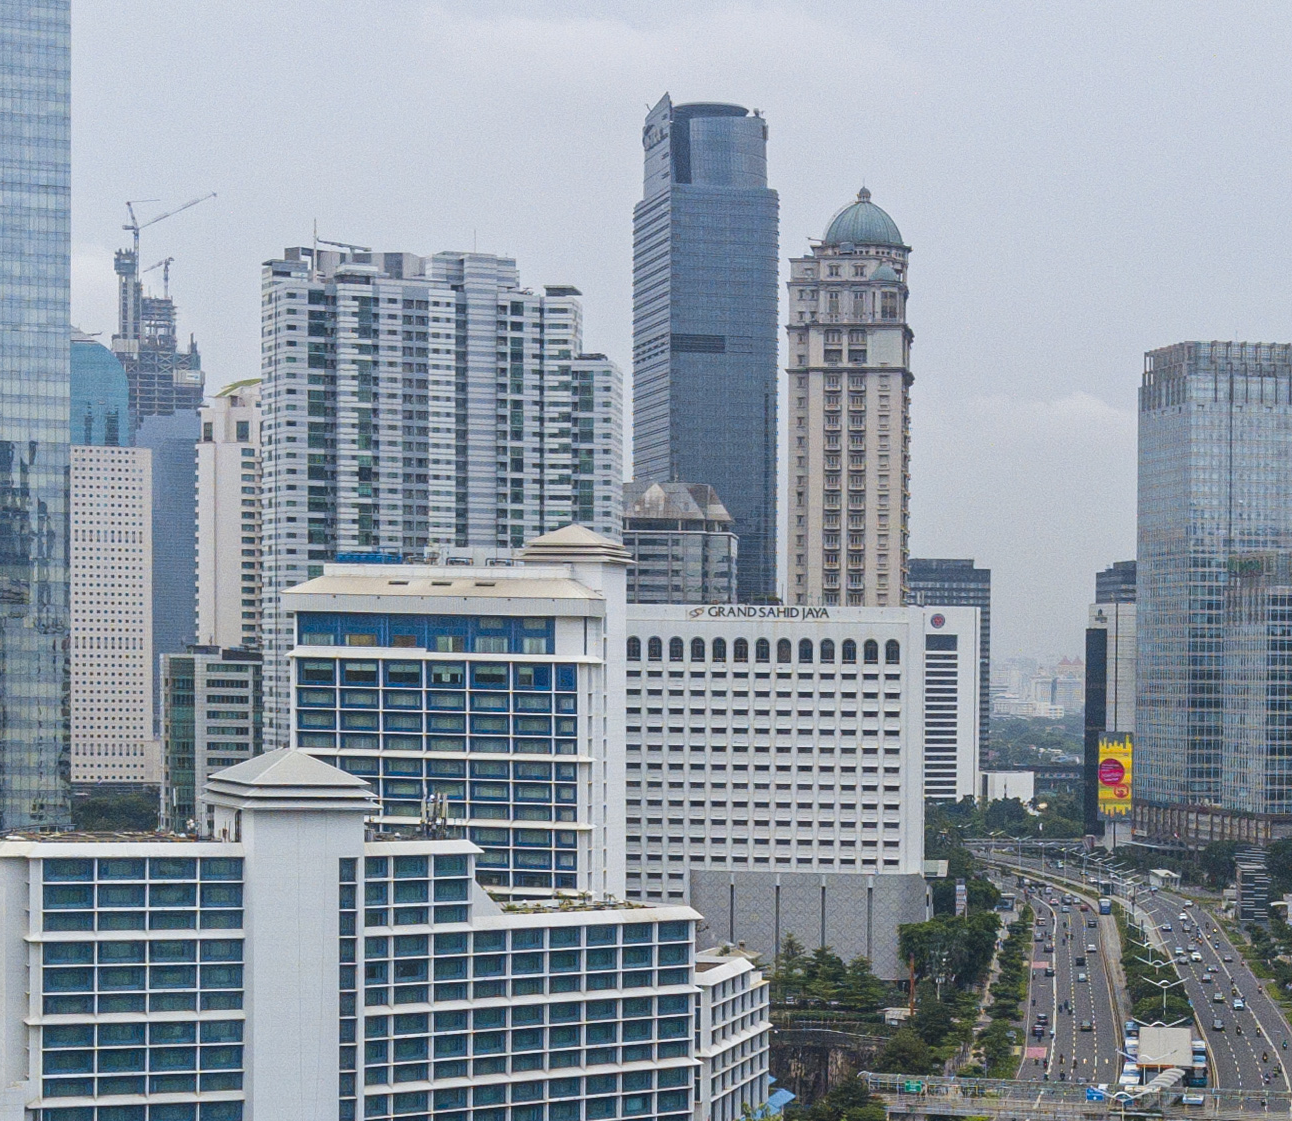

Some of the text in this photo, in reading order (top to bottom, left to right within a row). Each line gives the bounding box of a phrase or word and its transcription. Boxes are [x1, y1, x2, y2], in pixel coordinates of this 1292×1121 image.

[707, 606, 830, 620] GRAND SAHID JAYA
